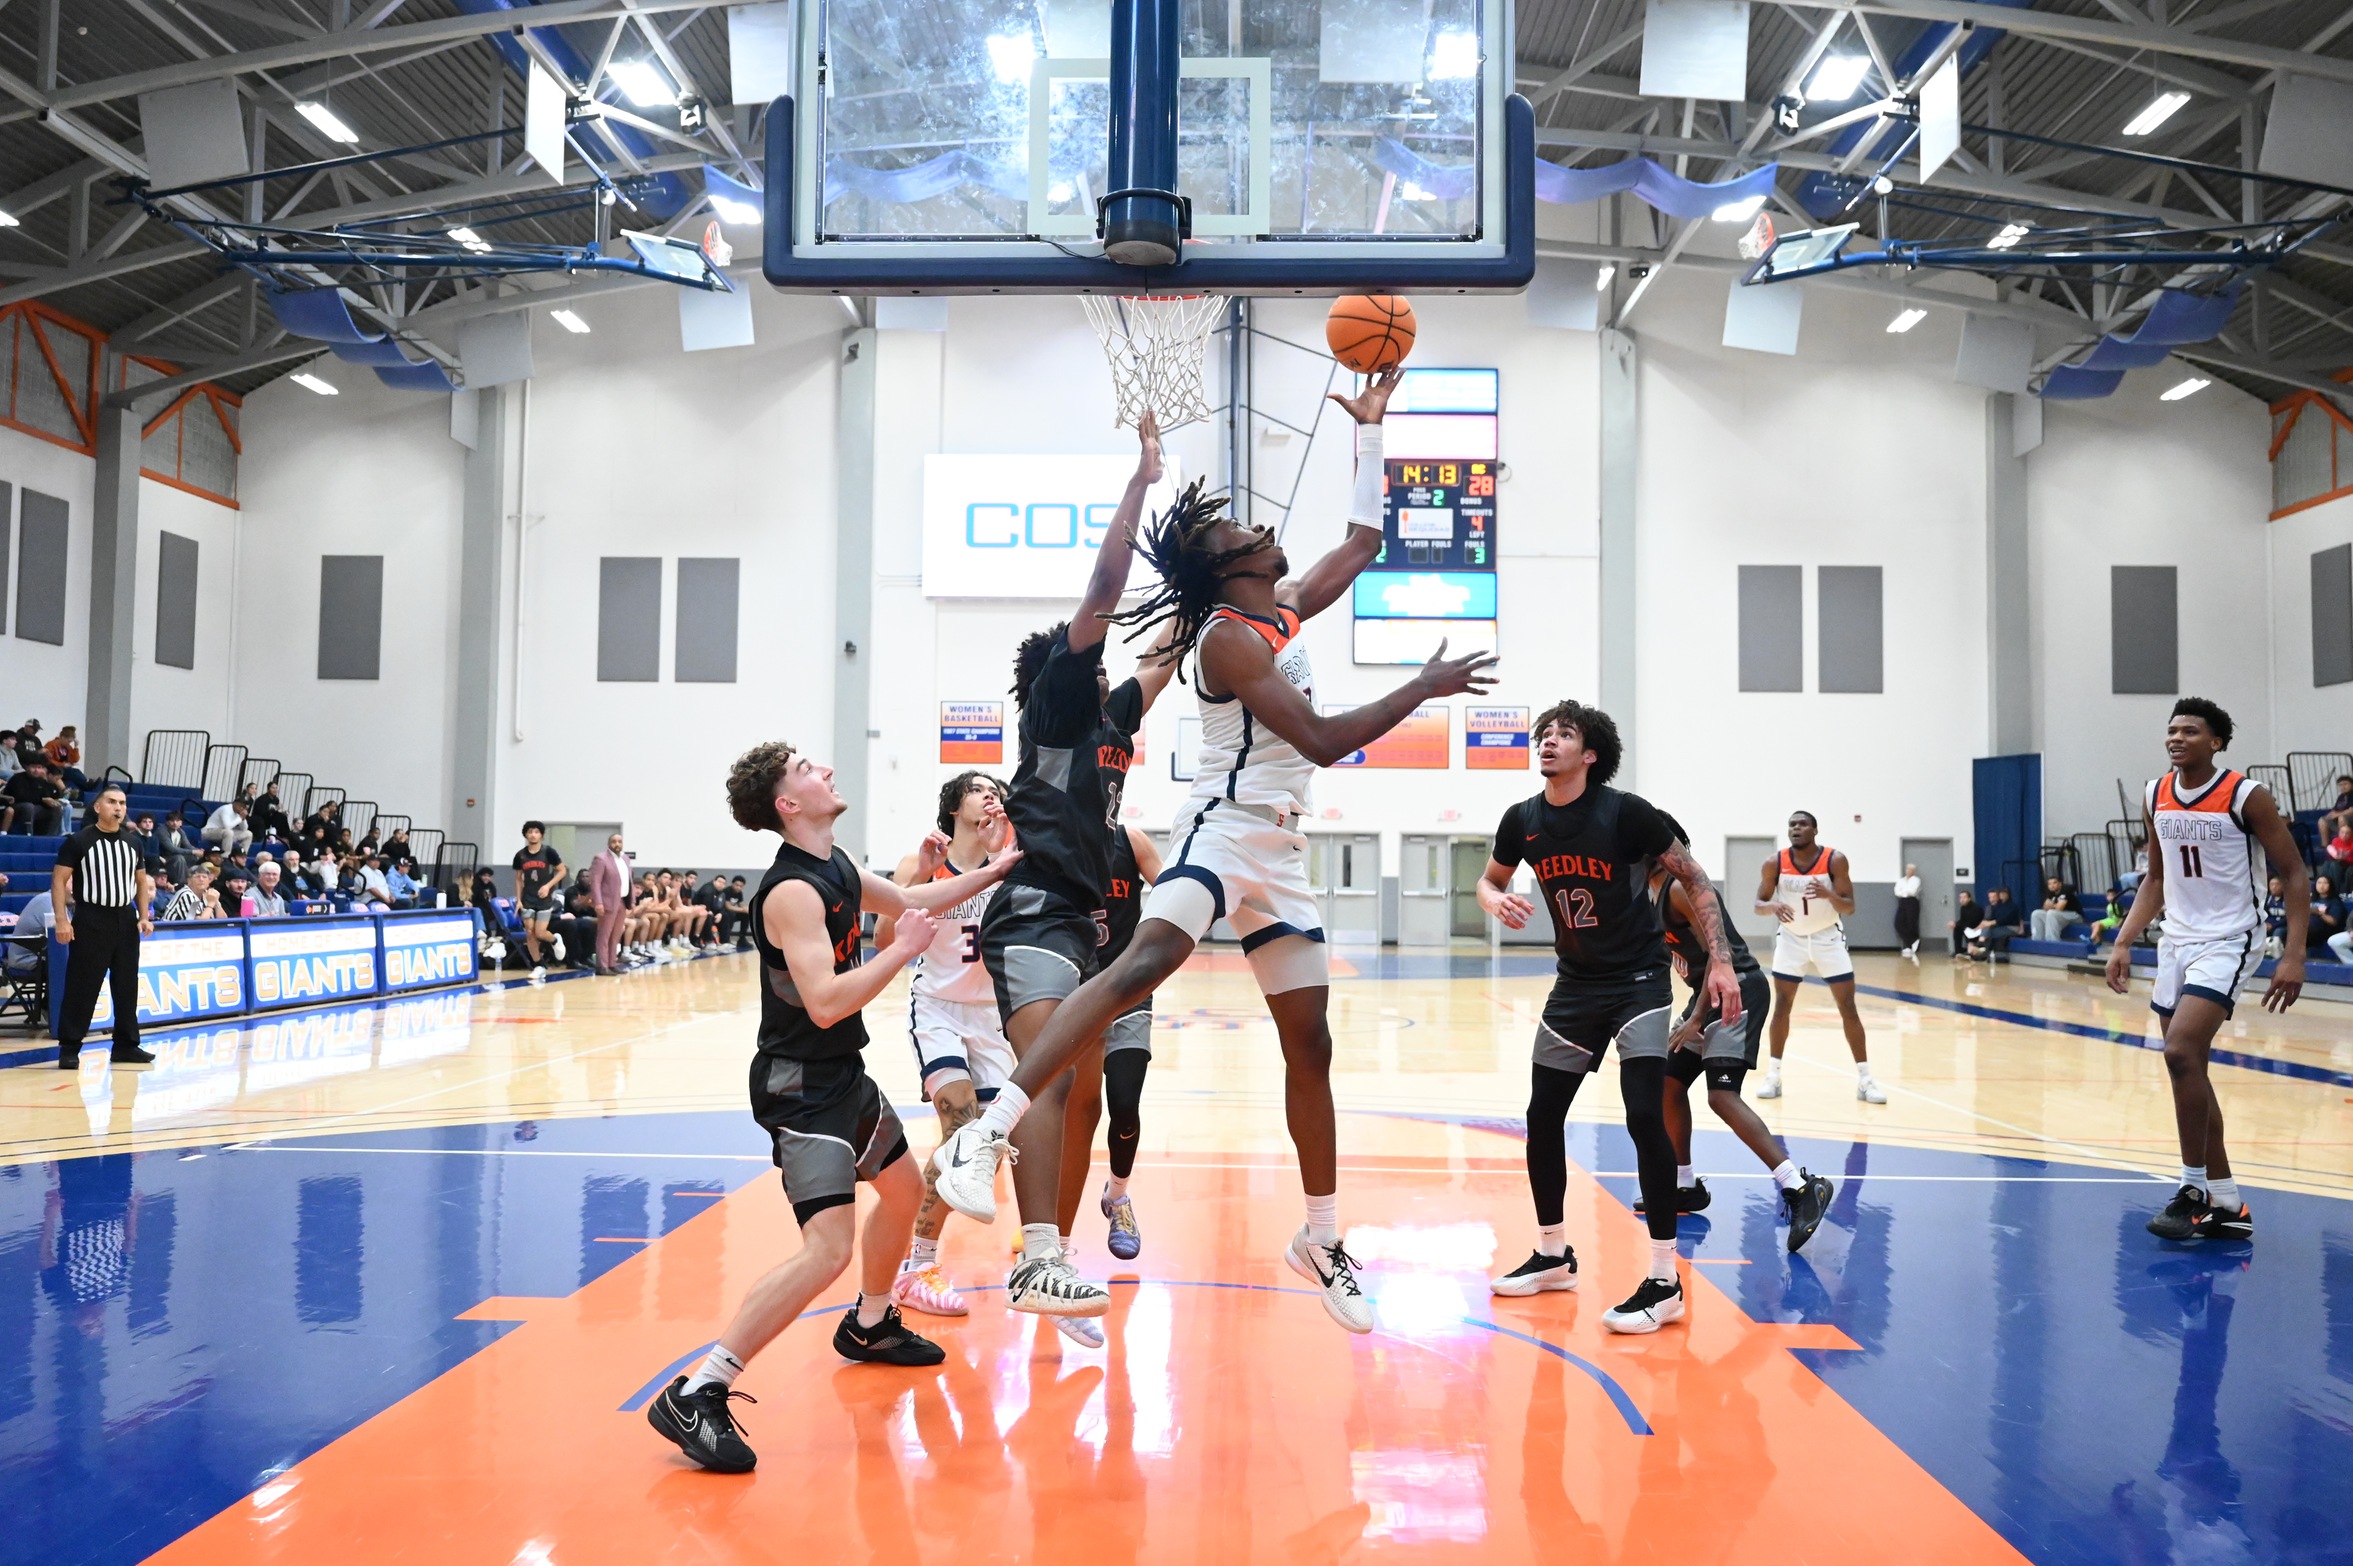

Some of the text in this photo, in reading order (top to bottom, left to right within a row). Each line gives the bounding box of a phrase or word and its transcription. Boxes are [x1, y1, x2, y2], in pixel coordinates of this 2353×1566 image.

[1403, 464, 1457, 484] 14:13
[1469, 475, 1494, 496] 28
[1433, 489, 1445, 506] 2
[1461, 508, 1493, 517] TIMEOUTS
[1471, 515, 1484, 531] 4
[1474, 547, 1486, 564] 3
[949, 705, 992, 713] WOMEN'S
[1469, 720, 1525, 728] VOLLEYBALL
[2160, 819, 2222, 840] GIANTS
[1534, 854, 1613, 884] REEDLEY
[2180, 845, 2203, 878] 11
[1555, 887, 1599, 930] 12
[1802, 896, 1809, 916] 1
[160, 944, 185, 961] OF
[190, 941, 225, 957] THE
[386, 943, 472, 985] GIANTS
[255, 953, 374, 1001] GIANTS
